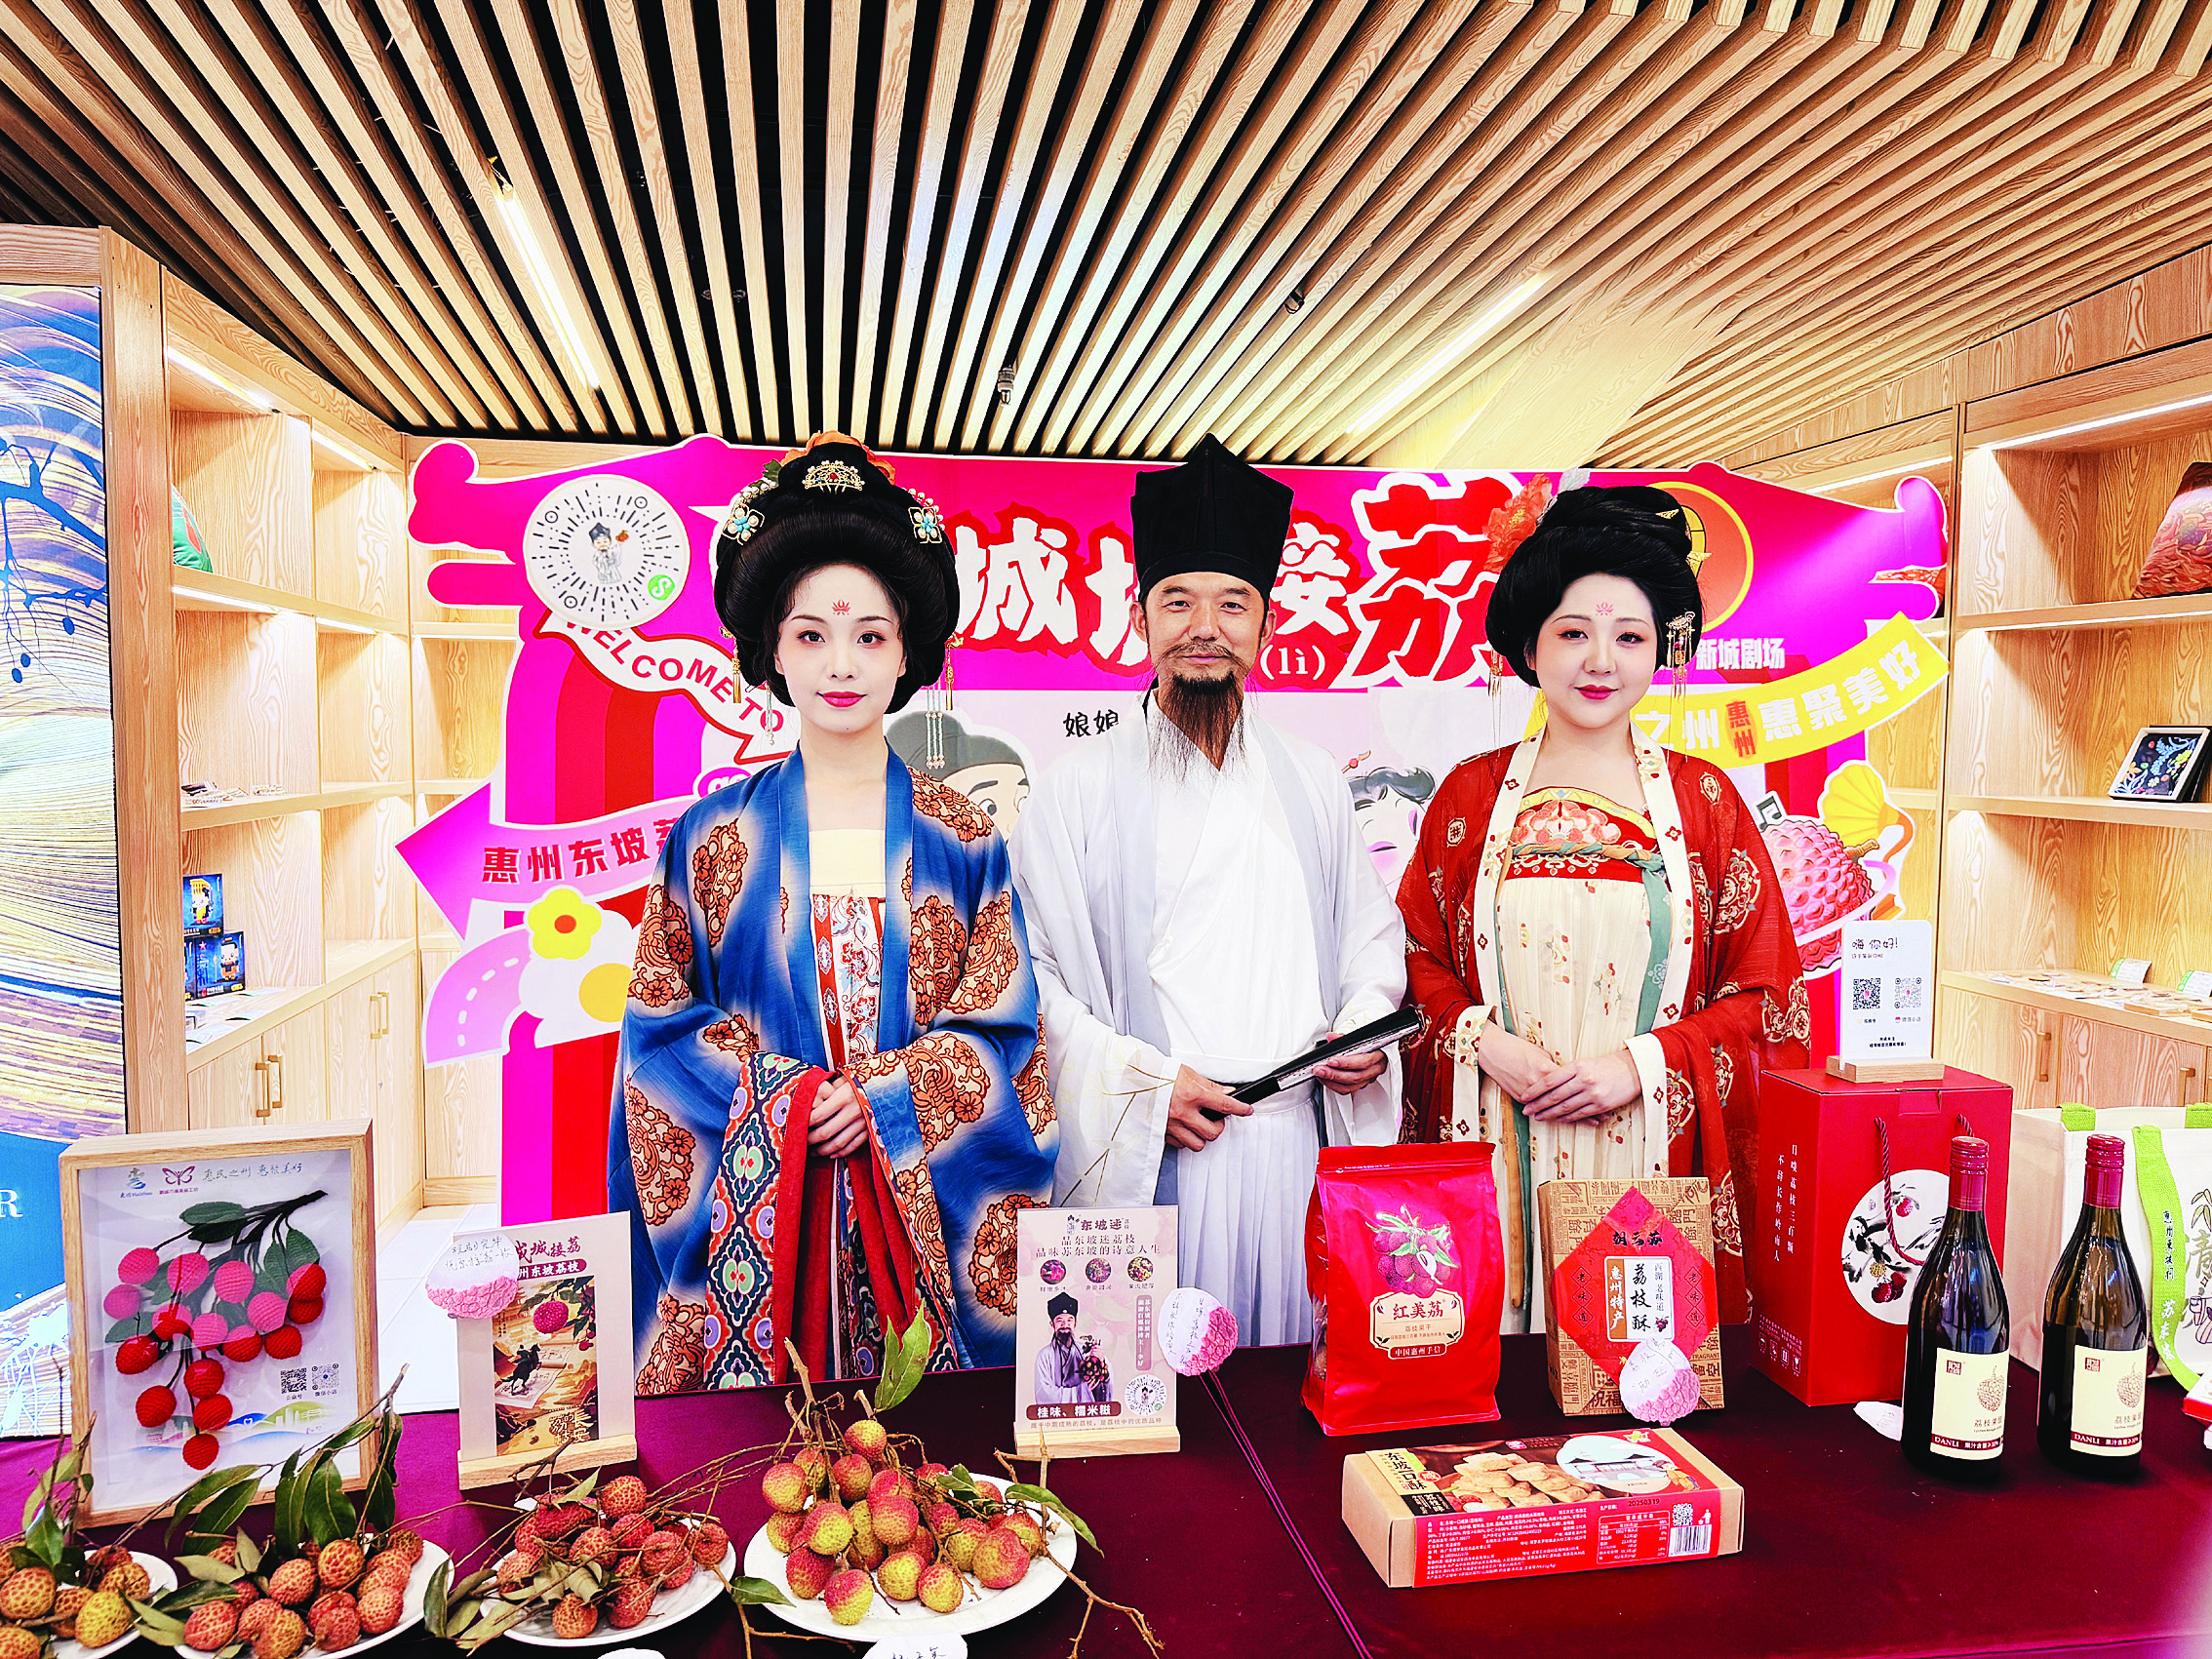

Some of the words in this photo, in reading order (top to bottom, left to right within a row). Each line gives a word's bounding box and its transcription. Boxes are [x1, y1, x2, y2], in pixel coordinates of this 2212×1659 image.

[1695, 637, 1786, 670] 新城剧场
[1758, 639, 1923, 742] 惠聚美好
[738, 696, 784, 733] TO
[1063, 709, 1120, 739] 娘娘
[1724, 700, 1757, 758] 惠州
[1036, 1244, 1161, 1258] 品味苏东坡的诗意人生
[1061, 1233, 1136, 1246] 品东坡迷荔枝
[1393, 1300, 1443, 1321] 红美荔
[1610, 1265, 1625, 1330] 惠州特产
[1630, 1263, 1652, 1332] 荔枝酥
[1395, 1346, 1441, 1357] 中国惠州手信
[1934, 1436, 1959, 1448] DANLI
[2074, 1433, 2100, 1445] DANLI
[1384, 1452, 1427, 1490] 东坡一口酥
[1628, 1498, 1660, 1507] 20250319
